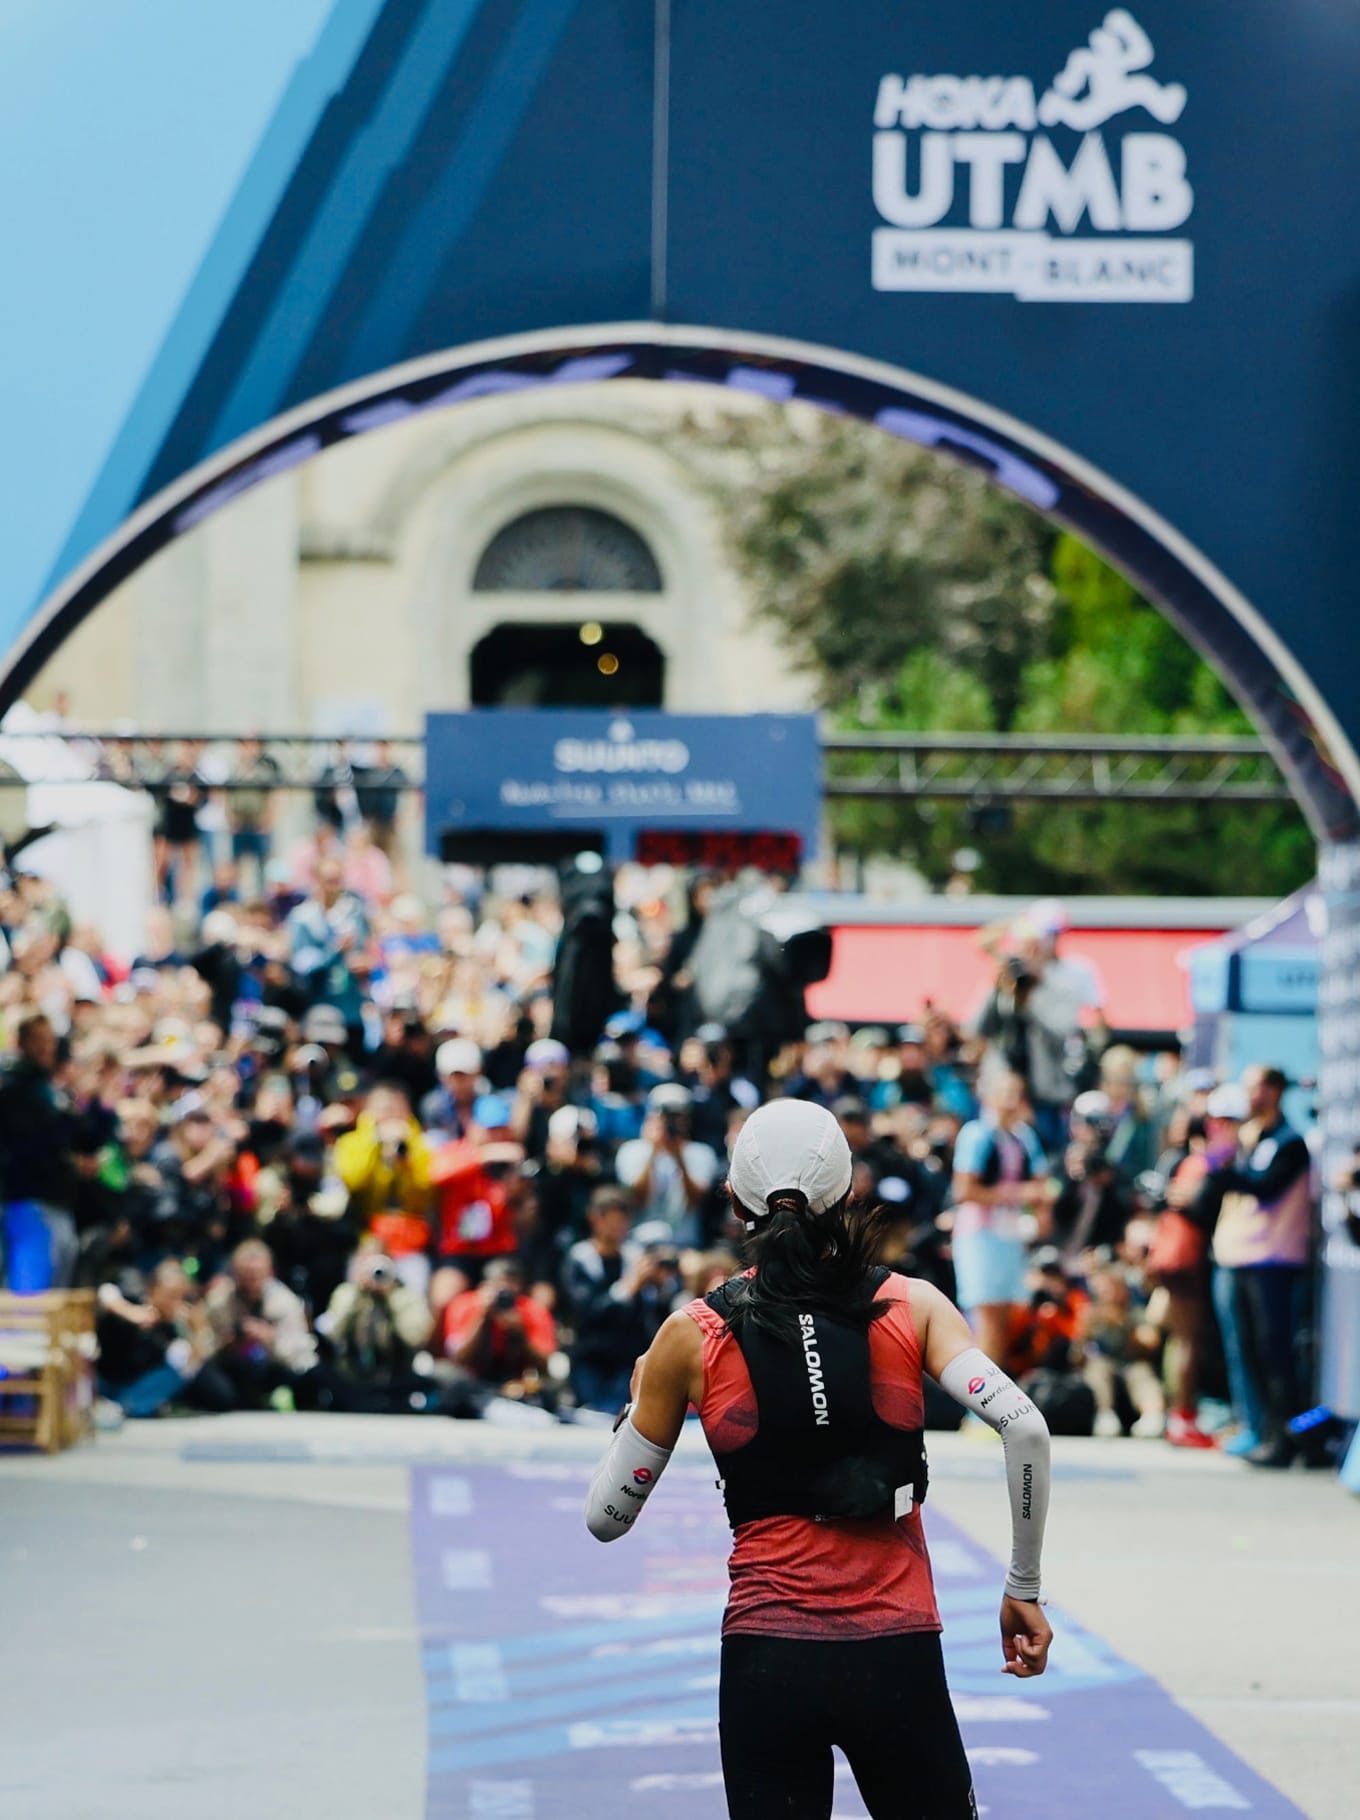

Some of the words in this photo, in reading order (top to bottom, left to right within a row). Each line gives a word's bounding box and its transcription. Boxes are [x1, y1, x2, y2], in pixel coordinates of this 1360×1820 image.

[873, 74, 1037, 130] HOKA
[872, 130, 1194, 234] UTMB
[798, 1313, 829, 1426] SALOMON
[1022, 1463, 1033, 1520] SALOMON
